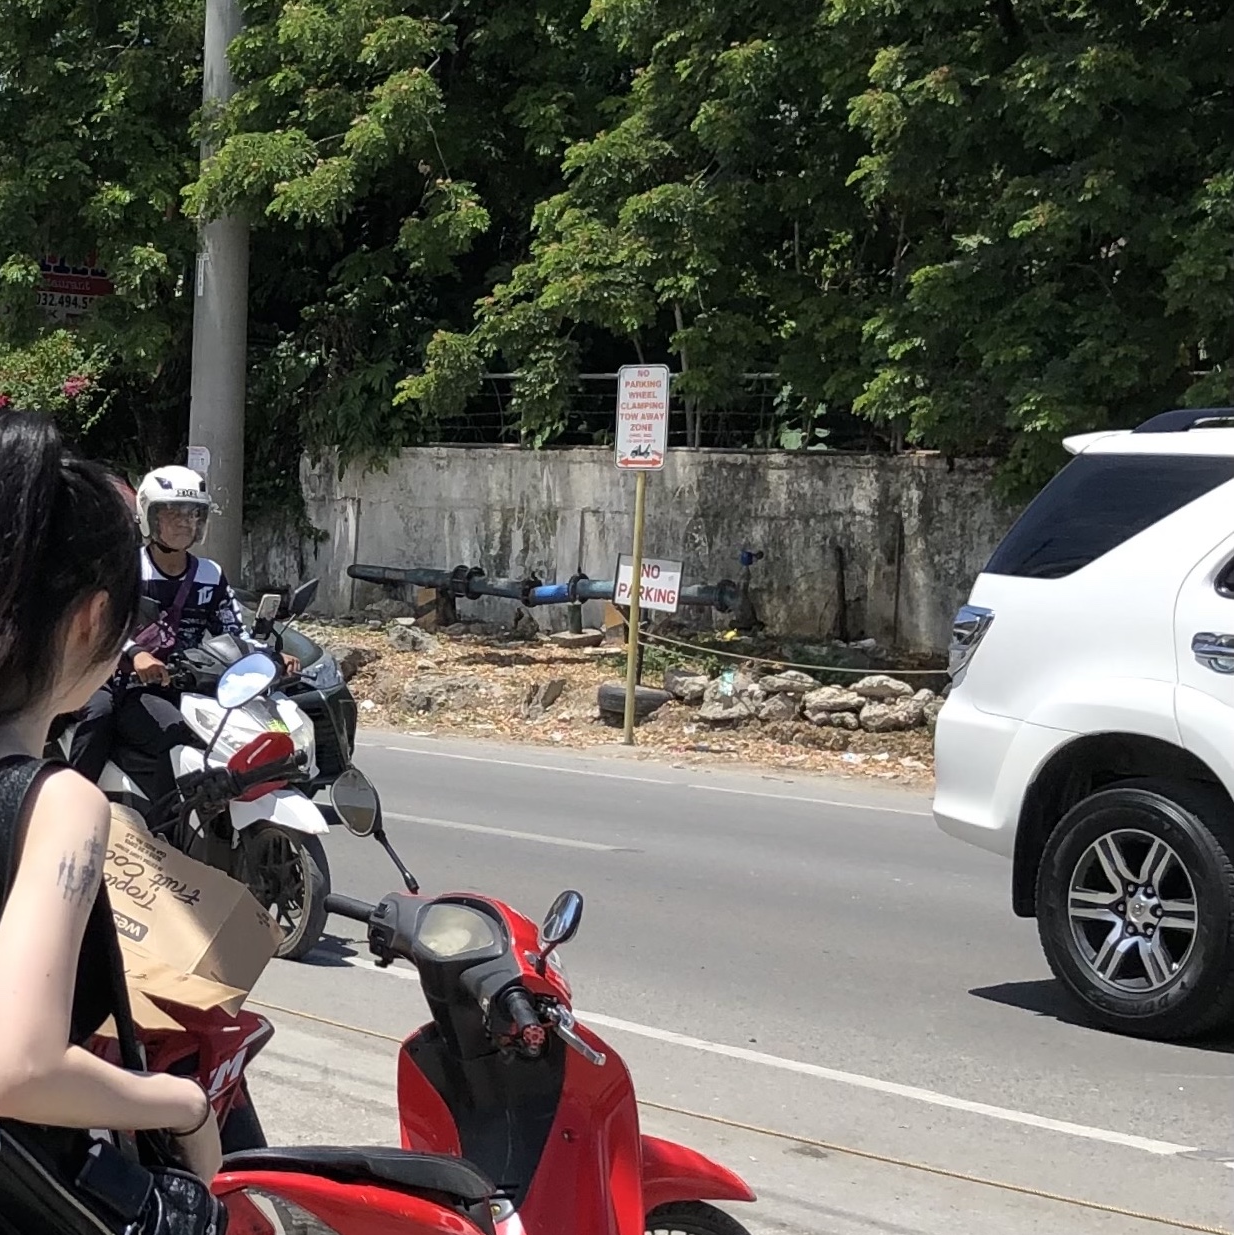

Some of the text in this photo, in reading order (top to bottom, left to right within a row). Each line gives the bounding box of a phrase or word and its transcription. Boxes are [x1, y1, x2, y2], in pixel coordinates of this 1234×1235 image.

[637, 369, 650, 378] NO
[625, 380, 662, 389] PARKING
[628, 391, 658, 399] WHEEL
[620, 402, 664, 410] CLAMPING
[620, 412, 665, 421] TOW AWAY
[629, 423, 653, 432] ZONE
[641, 563, 661, 579] NO
[148, 873, 201, 906] Fruit
